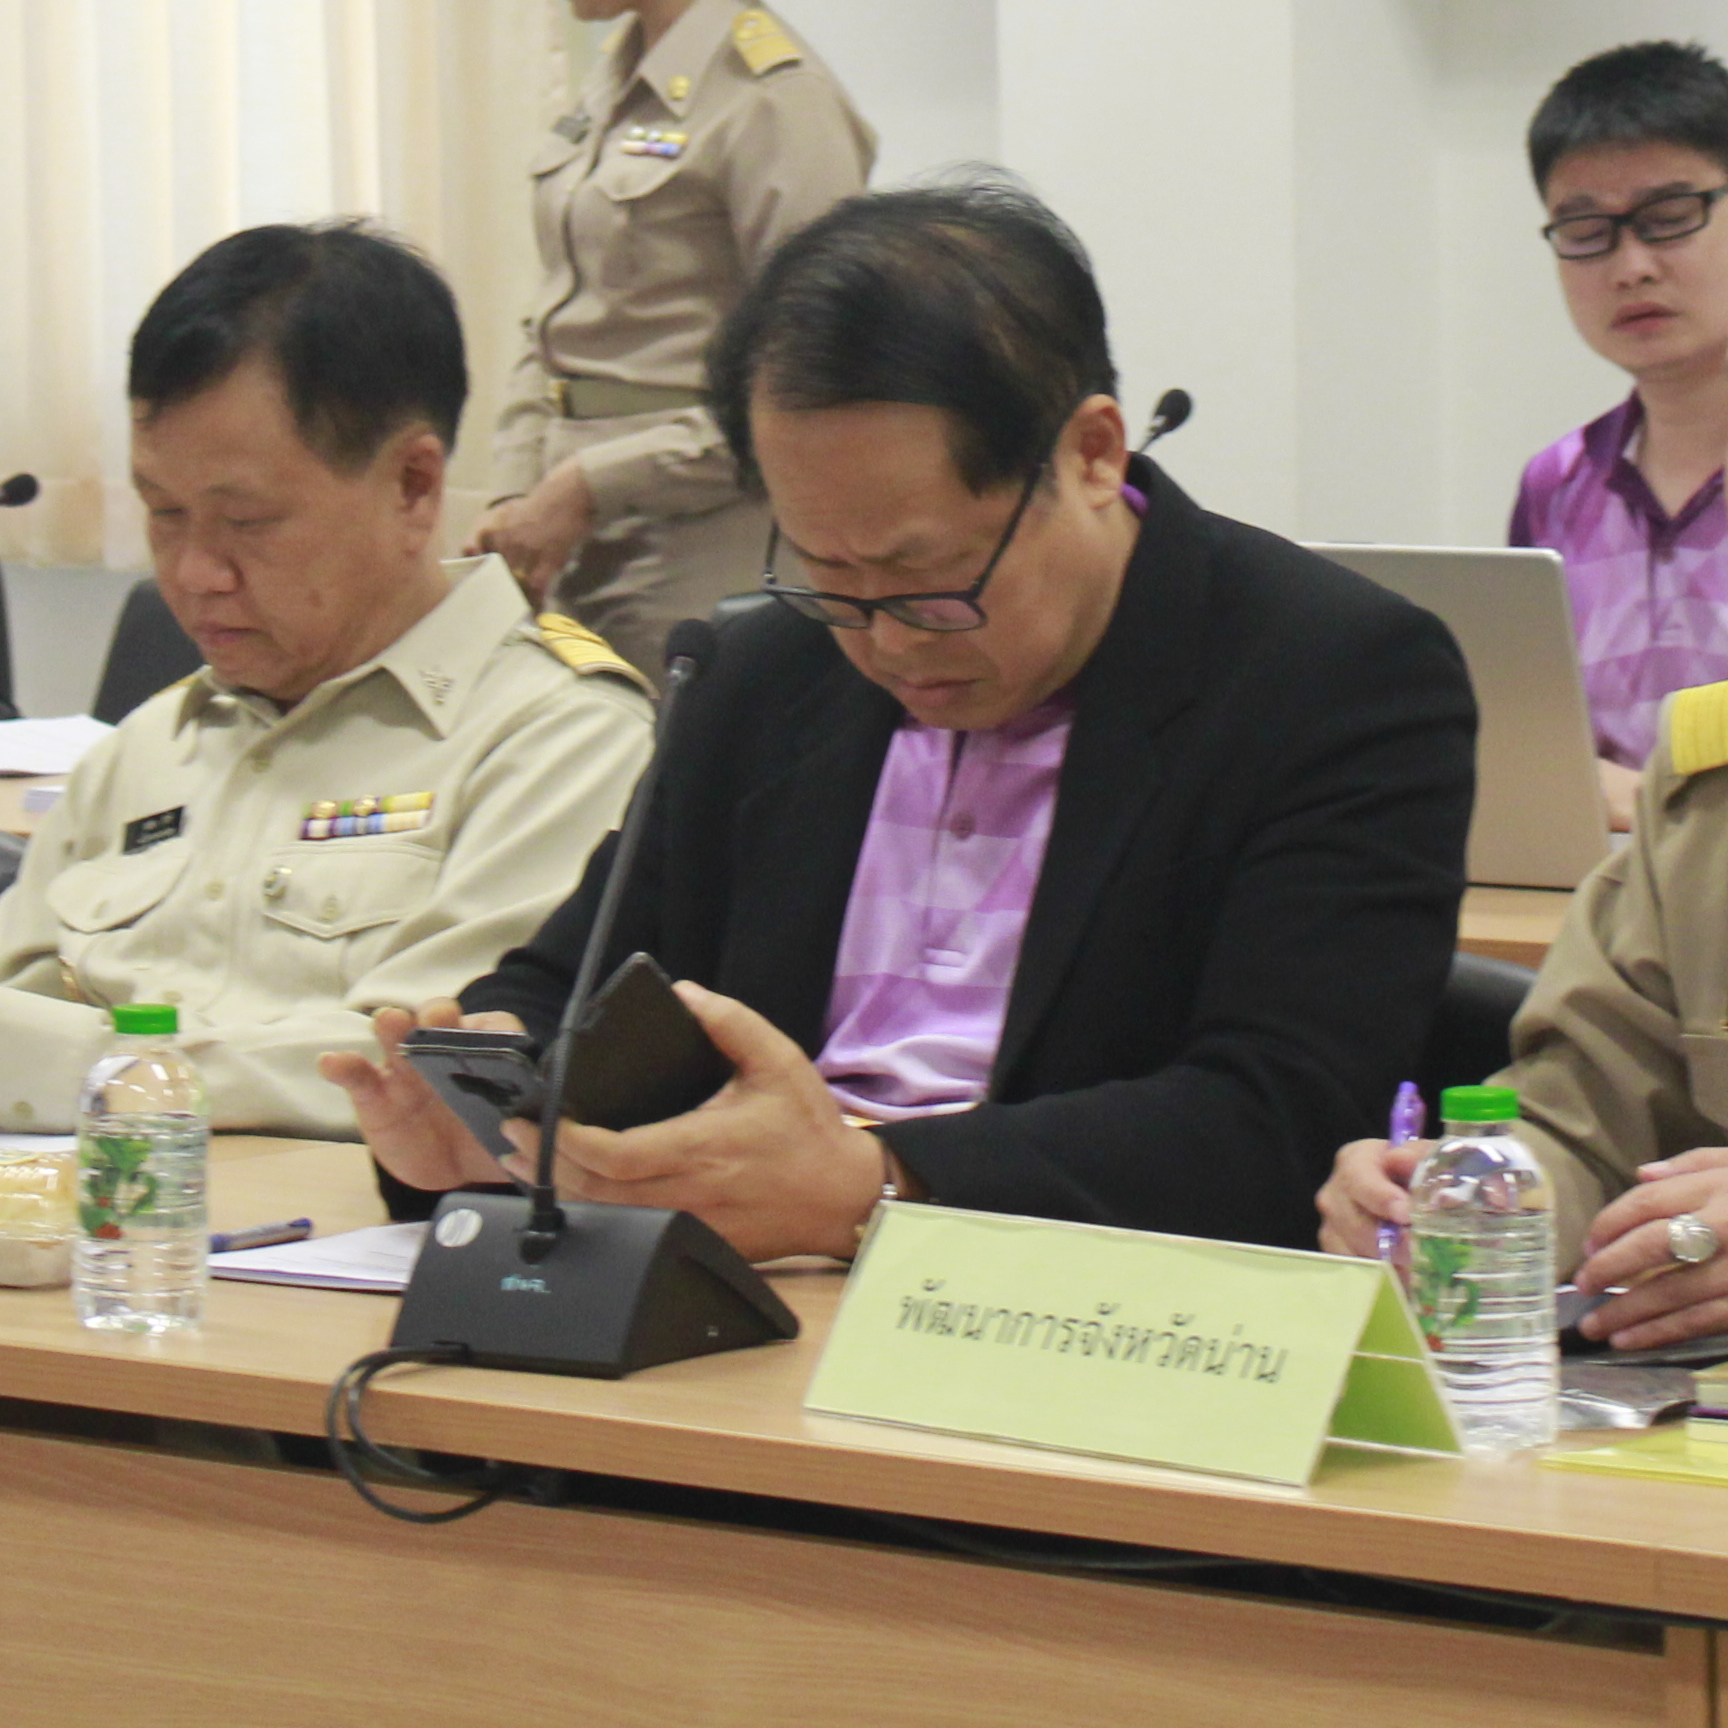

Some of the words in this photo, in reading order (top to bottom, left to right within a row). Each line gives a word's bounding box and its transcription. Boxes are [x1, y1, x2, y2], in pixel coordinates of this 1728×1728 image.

[895, 1276, 1290, 1384] พัฒนาการจังหวัดน่าน
